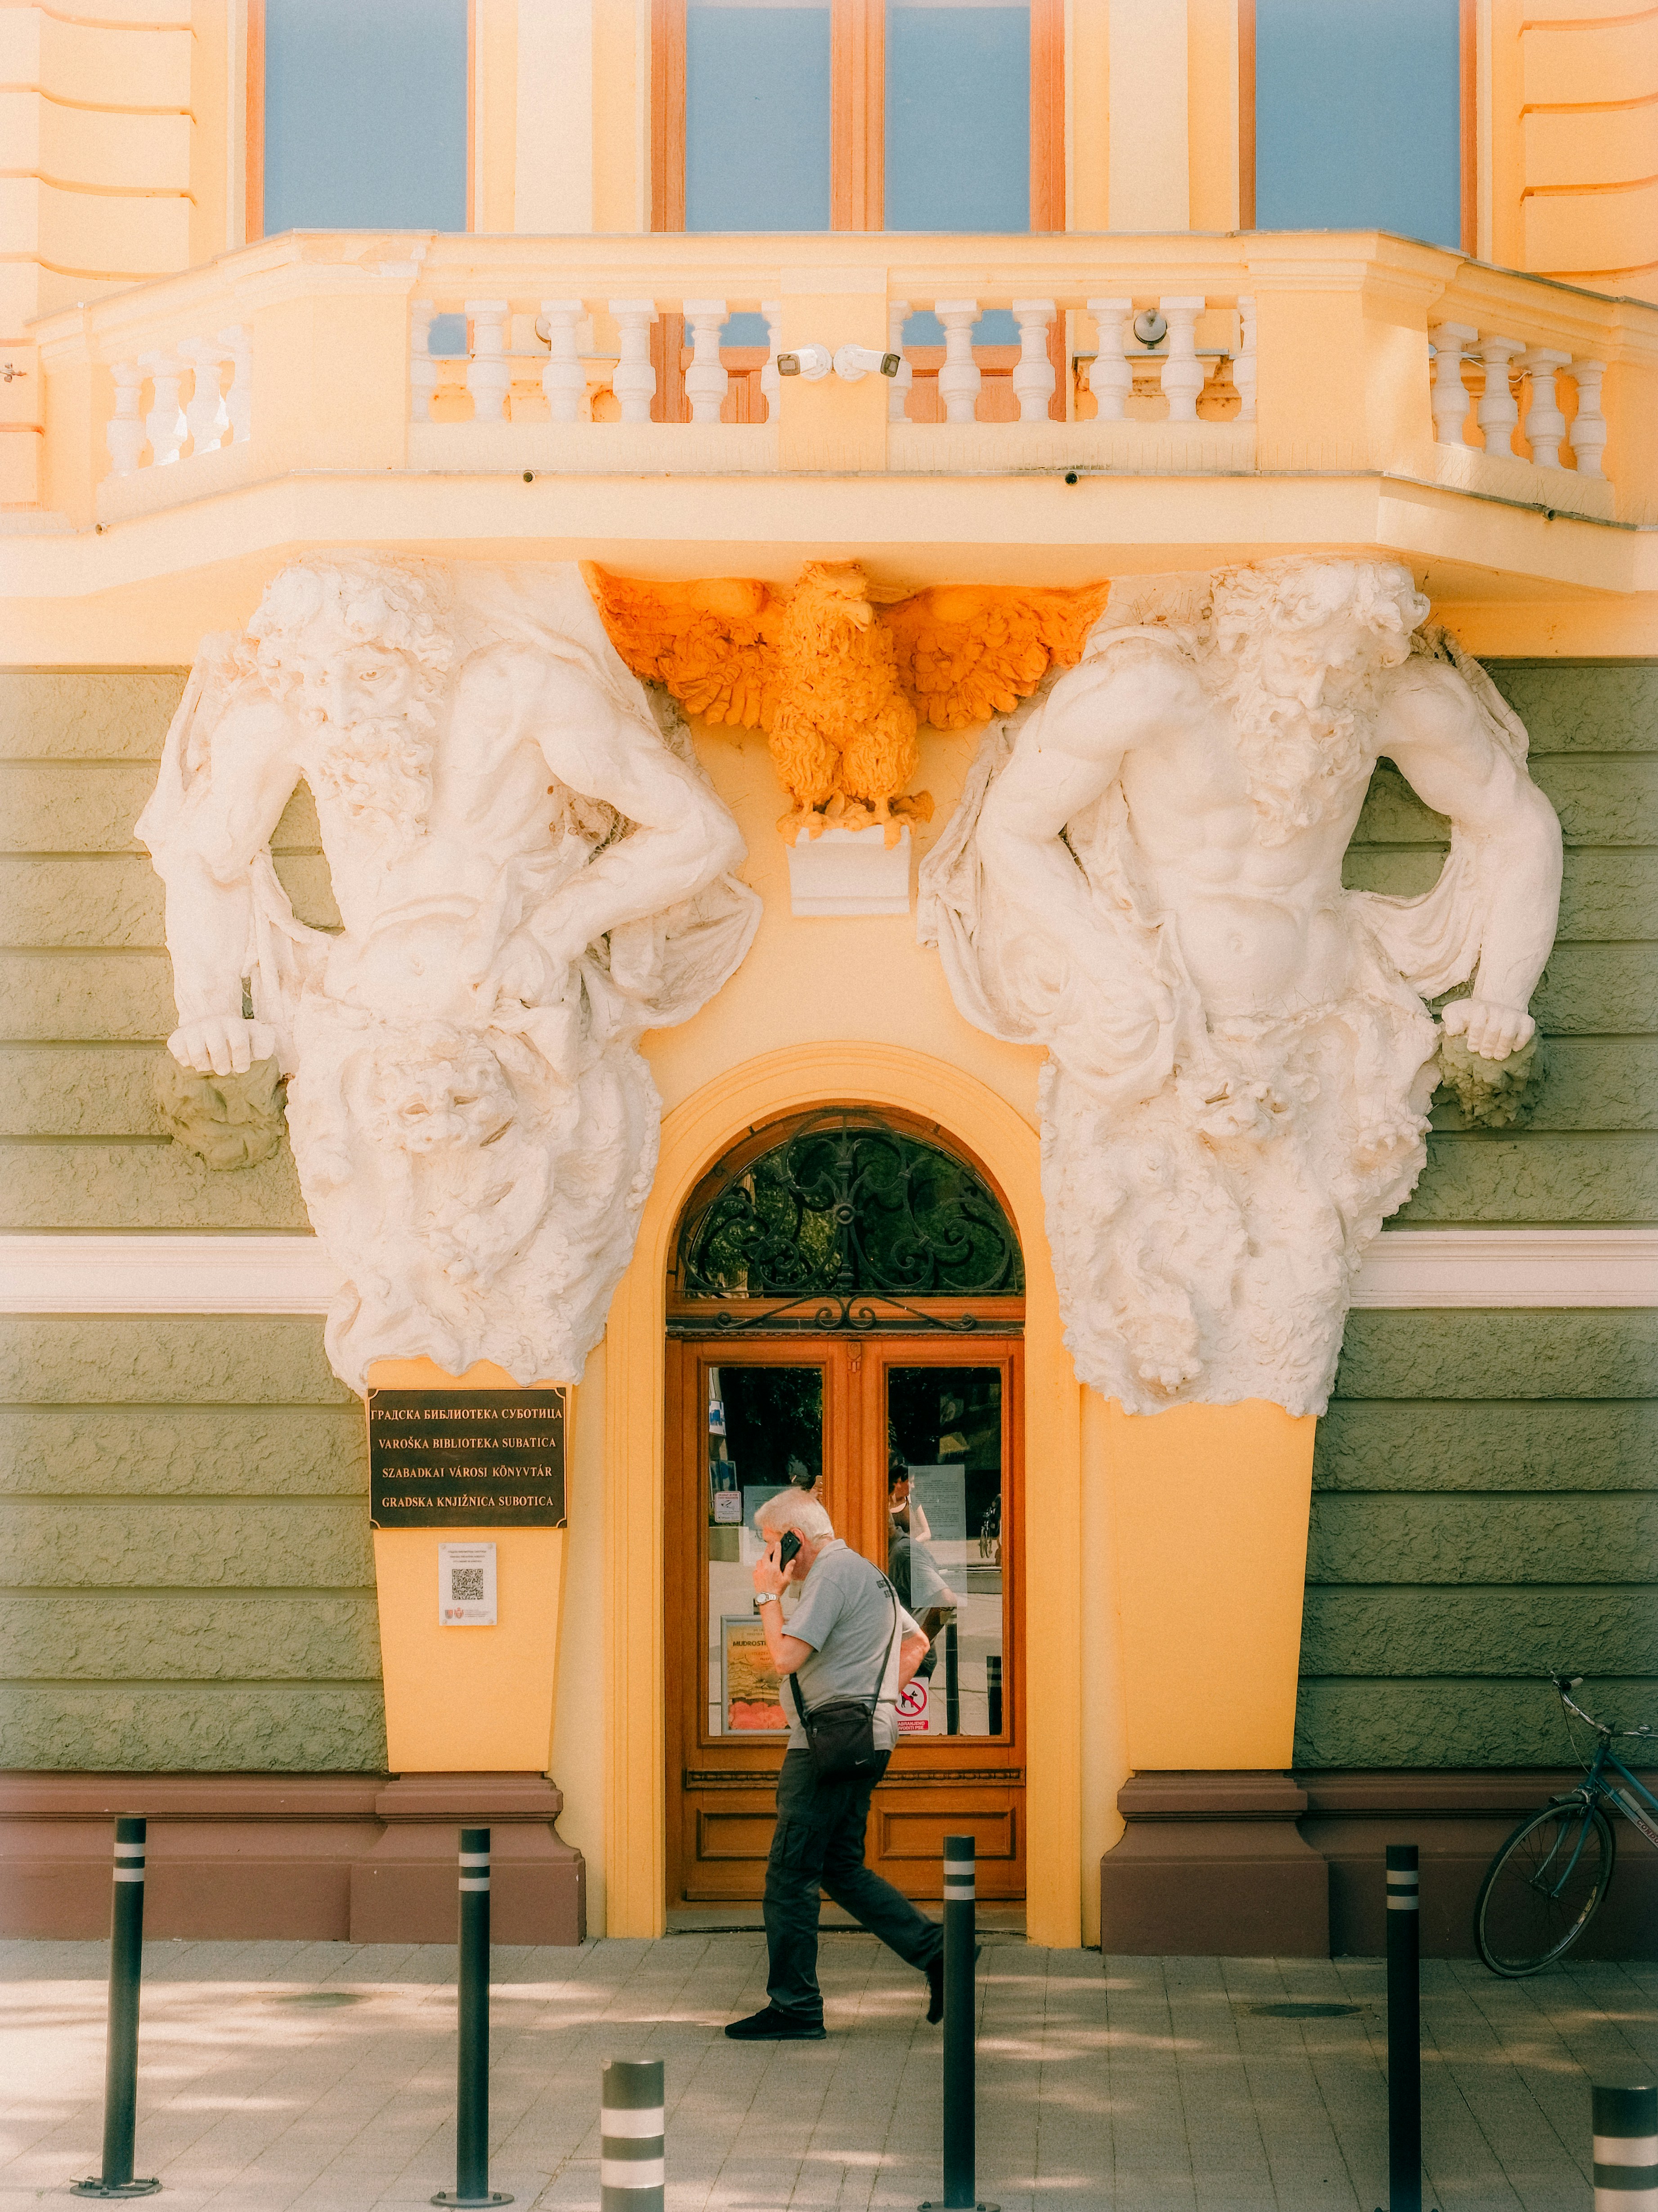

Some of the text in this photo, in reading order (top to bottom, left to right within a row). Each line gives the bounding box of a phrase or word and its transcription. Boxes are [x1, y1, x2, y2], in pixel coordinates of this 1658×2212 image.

[371, 1408, 563, 1421] ГРАДСКА БИБЛИОТЕКА СУБОТИЦА
[378, 1436, 556, 1449] VAROŠKA BIBLIOTEKA SUBATICA
[382, 1464, 552, 1478] SZABADKAI VÁROSI KÖNYVTÁR
[382, 1493, 554, 1507] GRADSKA KNJIŽNICA SUBOTICA
[1636, 1819, 1658, 1845] CONDO
